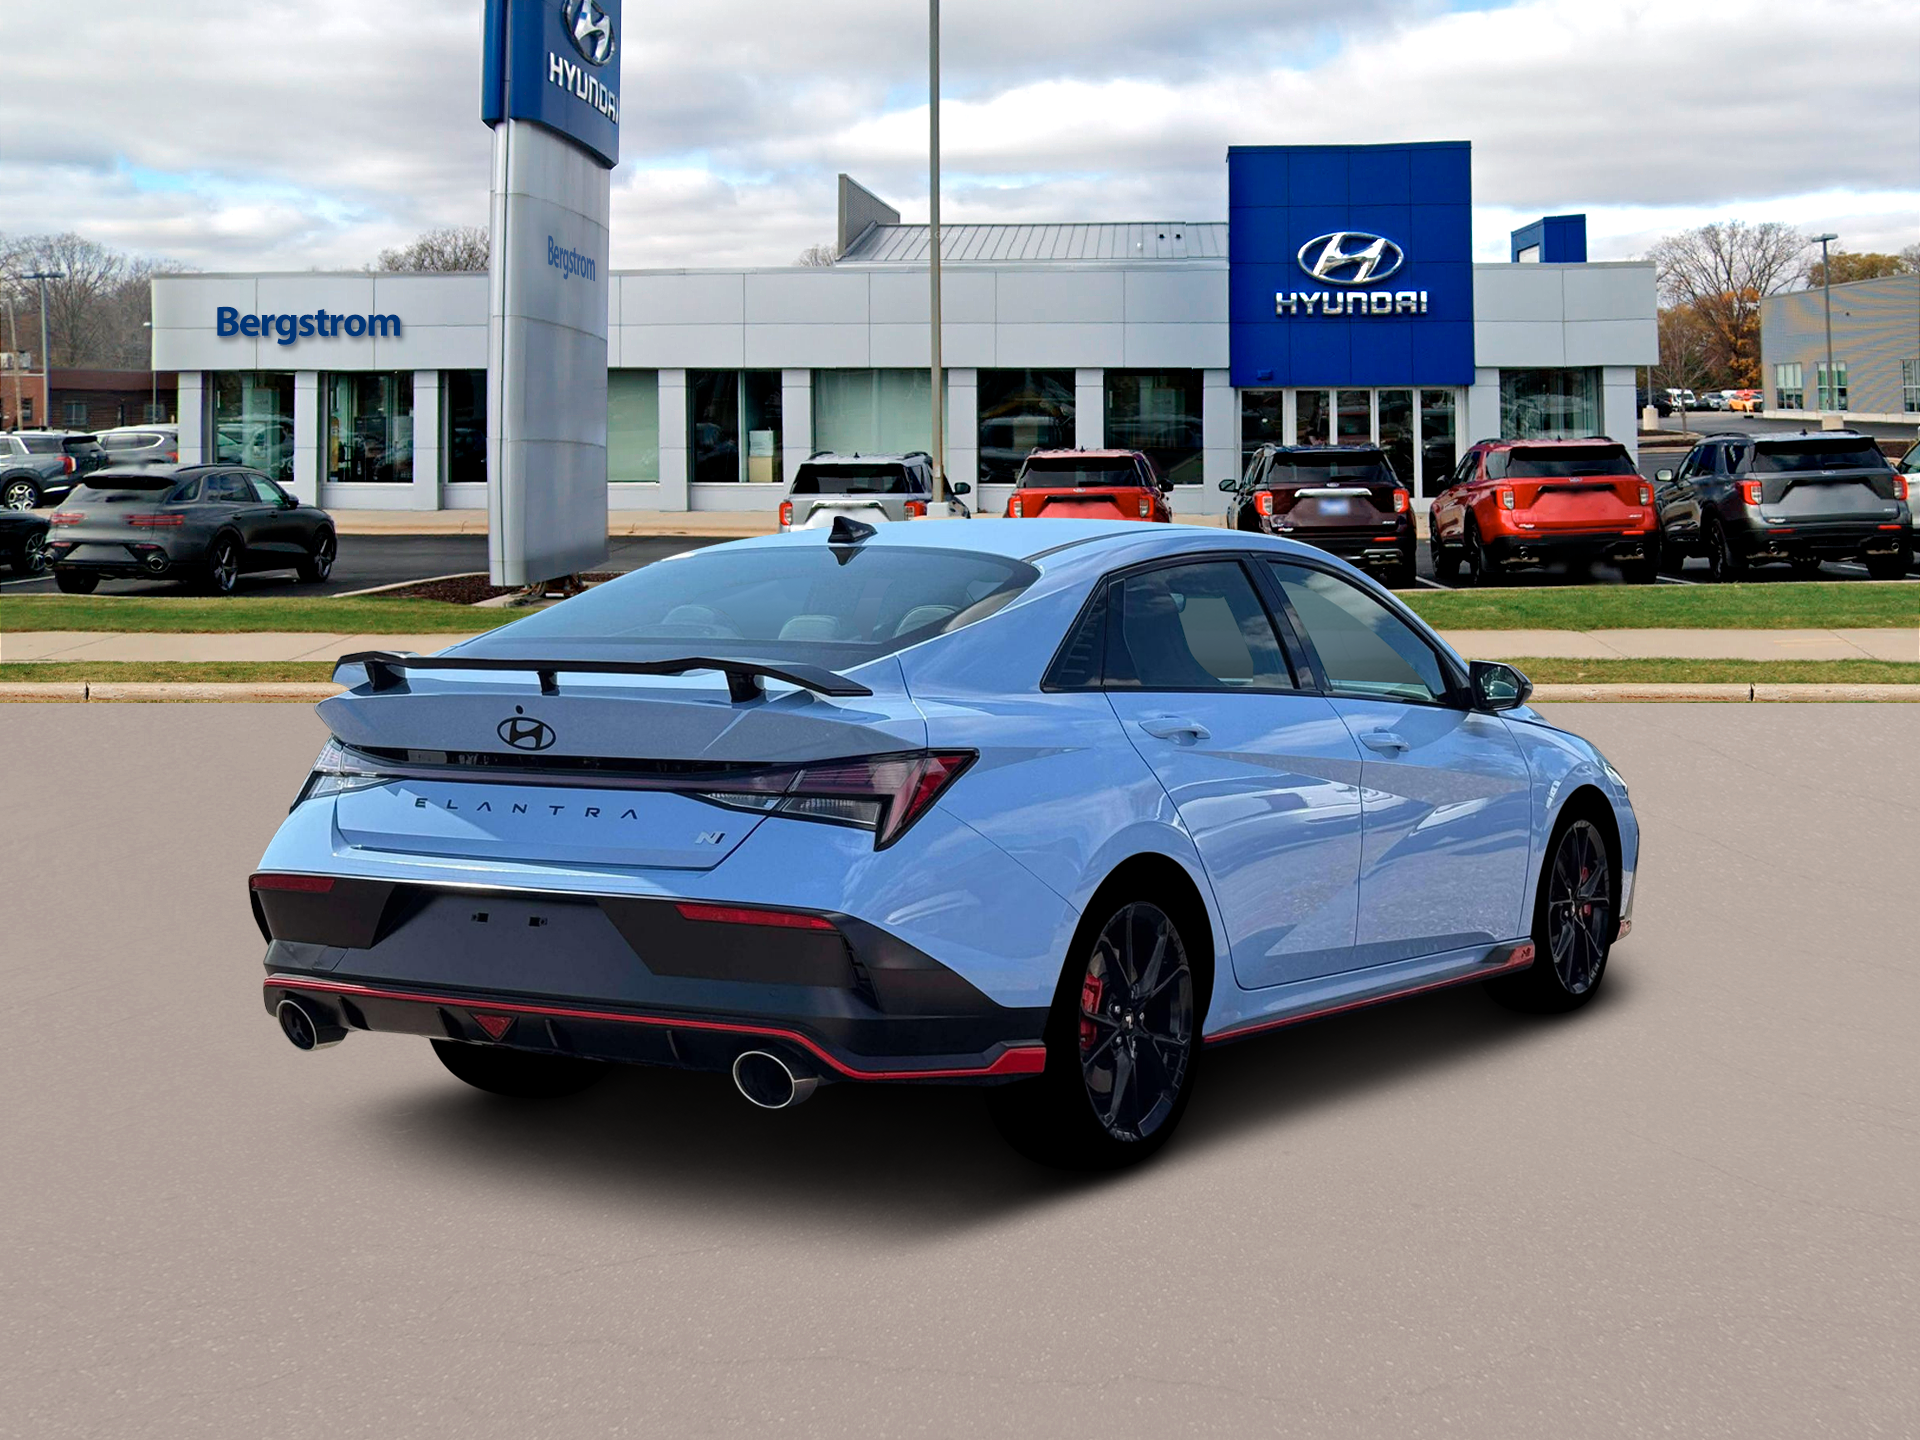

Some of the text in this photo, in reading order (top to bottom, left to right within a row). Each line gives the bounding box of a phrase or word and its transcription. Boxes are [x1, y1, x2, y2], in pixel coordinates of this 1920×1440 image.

[549, 52, 619, 123] HYUNDAI
[547, 235, 596, 282] Bergstrom
[1276, 291, 1428, 315] HYUNDAI
[217, 306, 401, 346] Bergstrom
[415, 797, 638, 820] ELANTRA
